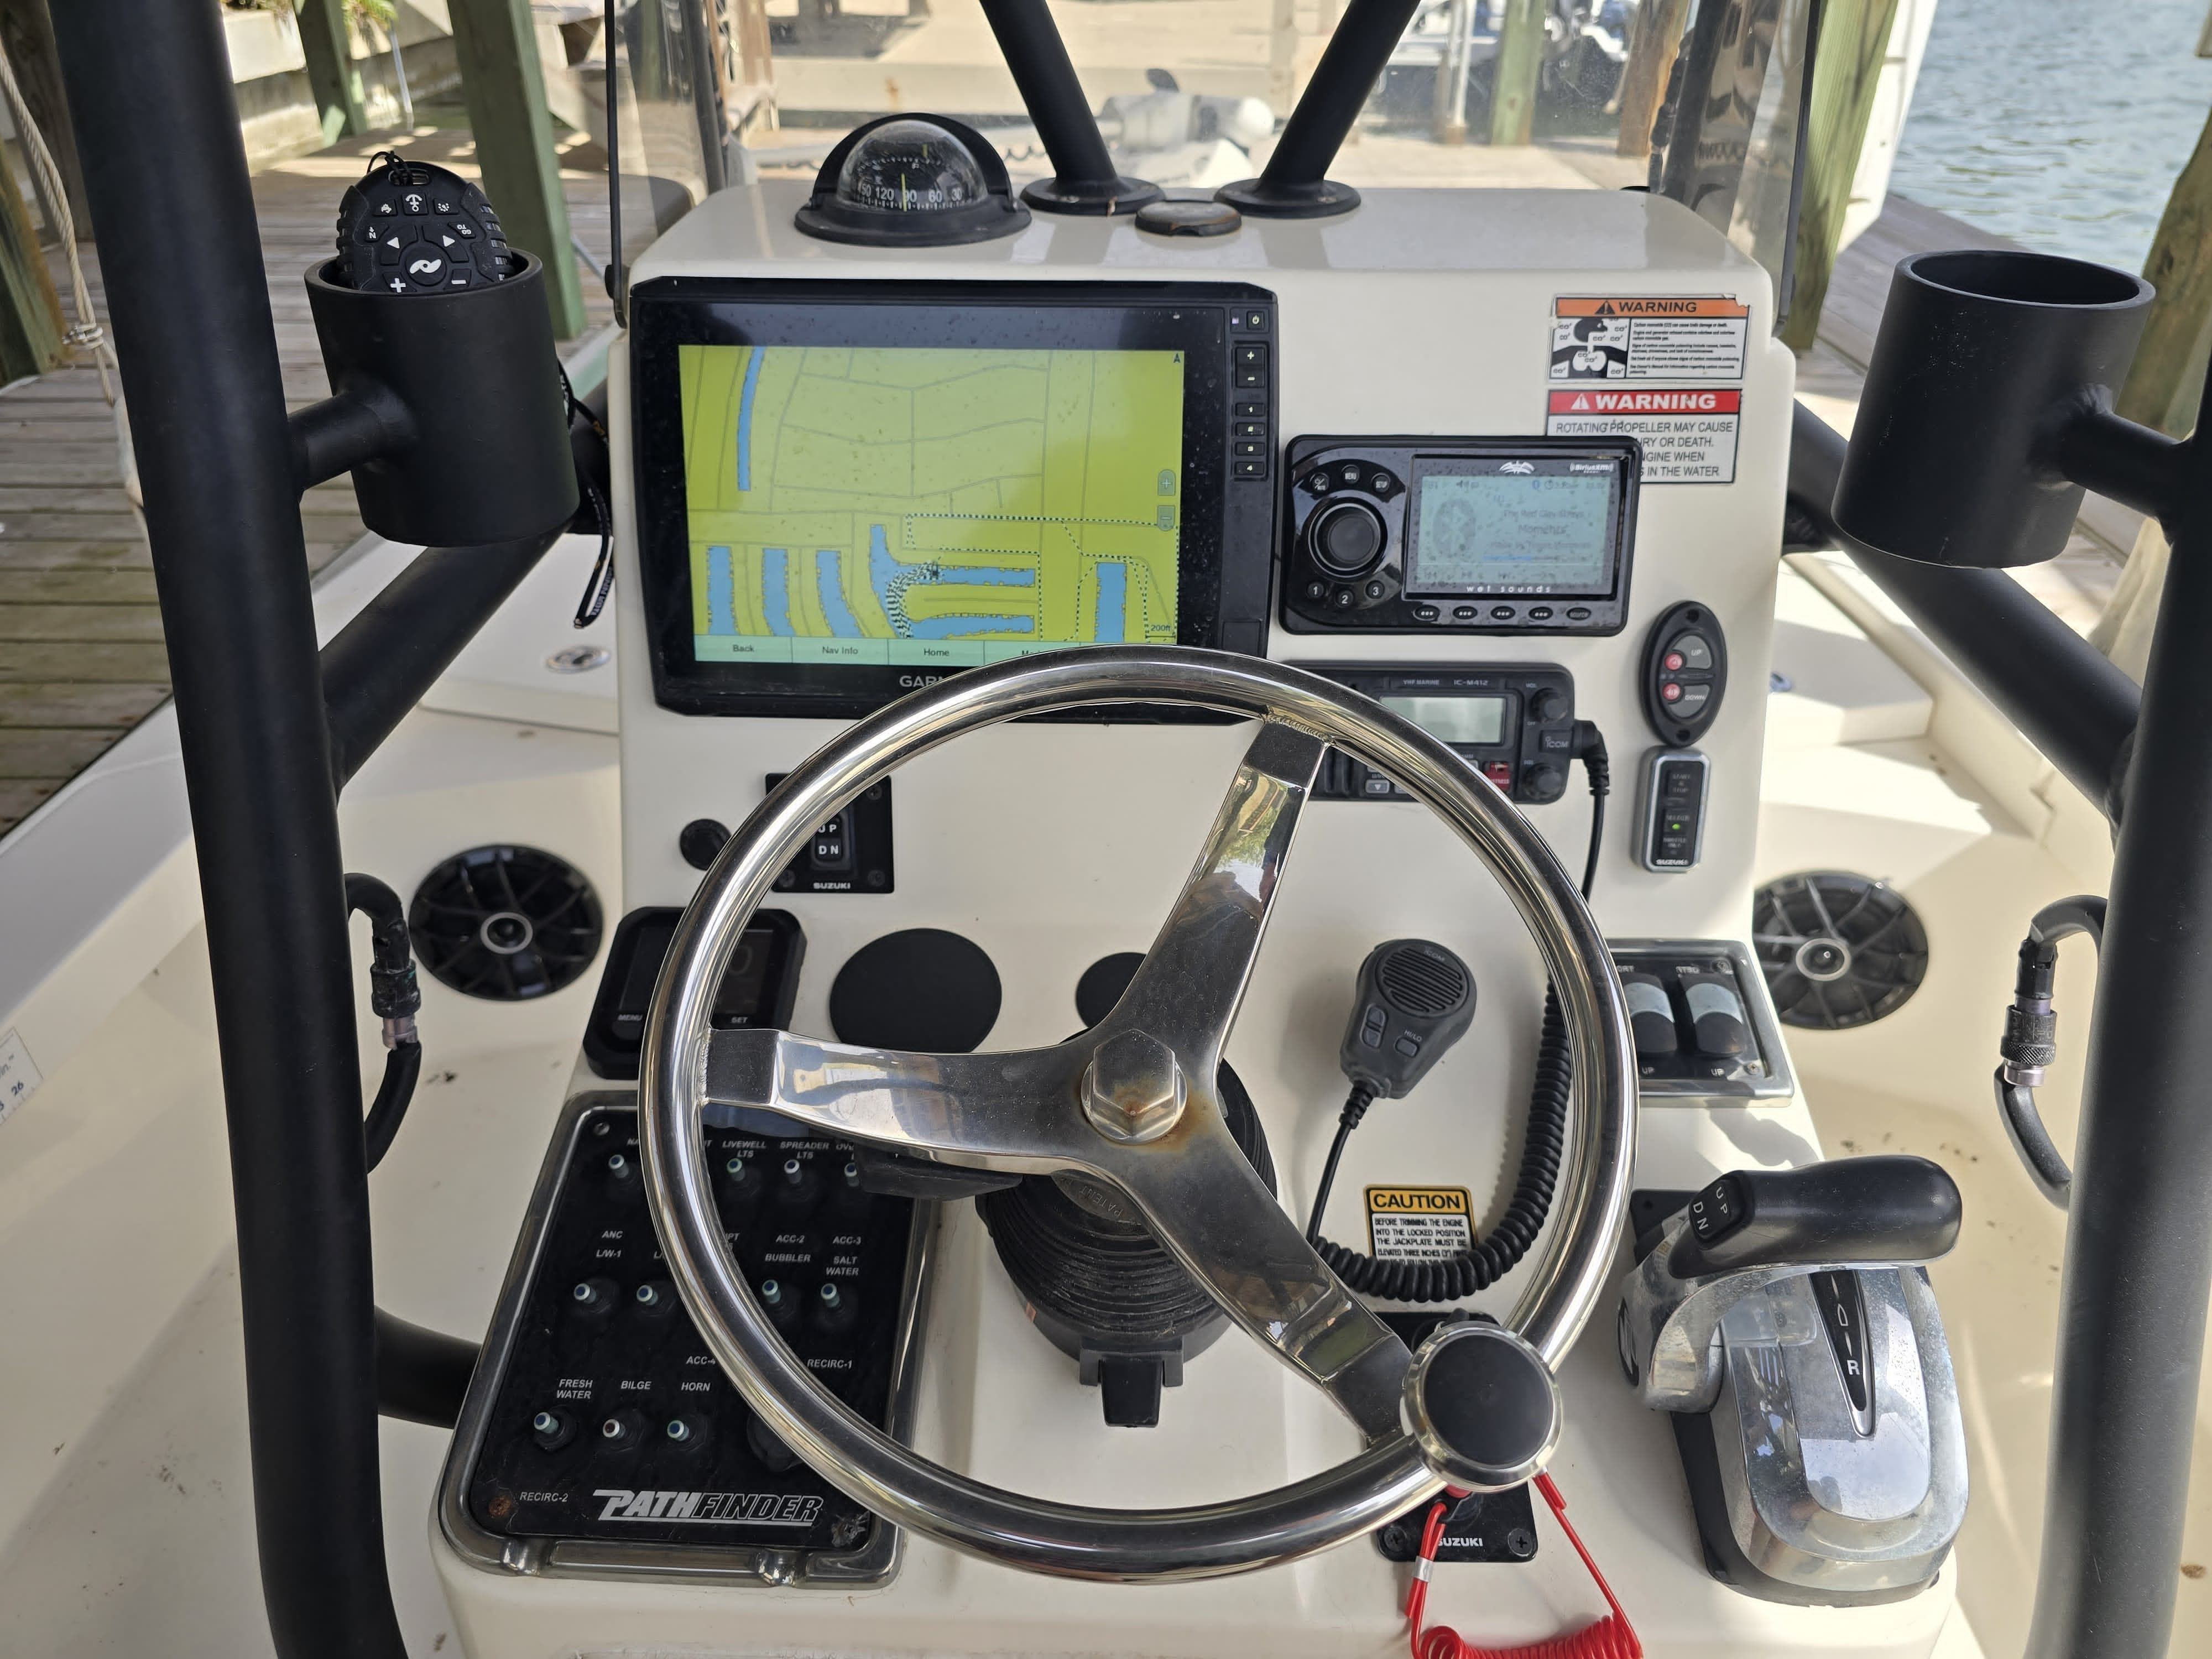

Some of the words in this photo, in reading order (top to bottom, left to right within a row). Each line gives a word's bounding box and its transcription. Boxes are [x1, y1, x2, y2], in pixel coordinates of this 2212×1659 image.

[875, 187, 894, 200] 120
[928, 189, 943, 202] 60
[1619, 301, 1697, 313] WARNING
[1595, 394, 1717, 409] WARNING
[1556, 422, 1607, 433] ROTATING
[1610, 422, 1671, 433] PROPELLER
[1673, 422, 1695, 432] MAY
[1698, 421, 1733, 432] CAUSE
[1660, 437, 1674, 447] OR
[1677, 437, 1714, 447] DEATH.
[1674, 451, 1704, 461] WHEN
[1648, 467, 1657, 476] IN
[1660, 466, 1681, 476] THE
[1683, 466, 1719, 476] WATER
[1313, 587, 1318, 595] 1
[1372, 587, 1379, 596] 3
[1500, 585, 1551, 593] sounds
[1342, 595, 1348, 604] 2
[732, 644, 754, 653] Back
[822, 646, 839, 654] Nav
[842, 646, 859, 655] Info
[924, 648, 950, 656] Home
[818, 823, 837, 833] UP
[818, 844, 839, 854] DN
[1641, 1066, 1655, 1074] UP
[626, 1138, 640, 1146] NA
[722, 1141, 767, 1149] LIVEWELL
[779, 1141, 830, 1150] SPREADER
[737, 1150, 754, 1159] LTS
[796, 1151, 814, 1160] LTS
[1373, 1193, 1460, 1209] CAUTION
[1375, 1218, 1397, 1226] BEFORE
[1429, 1218, 1441, 1227] THE
[1442, 1219, 1463, 1227] ENGINE
[601, 1230, 624, 1239] ANC
[775, 1234, 805, 1244] ACC-2
[832, 1236, 862, 1245] ACC-3
[1393, 1238, 1432, 1246] JACKPLATE
[1378, 1248, 1402, 1256] ELEVATED
[765, 1253, 811, 1262] BUBBLER
[833, 1255, 858, 1265] SALT
[826, 1266, 859, 1276] WATER
[807, 1358, 852, 1369] RECIRC-1
[1846, 1360, 1860, 1375] R
[559, 1379, 593, 1389] FRESH
[620, 1380, 651, 1390] BILGE
[681, 1382, 711, 1392] HORN
[556, 1390, 592, 1399] WATER
[519, 1491, 569, 1503] RECIRC-2
[592, 1489, 825, 1527] PATHFINDER
